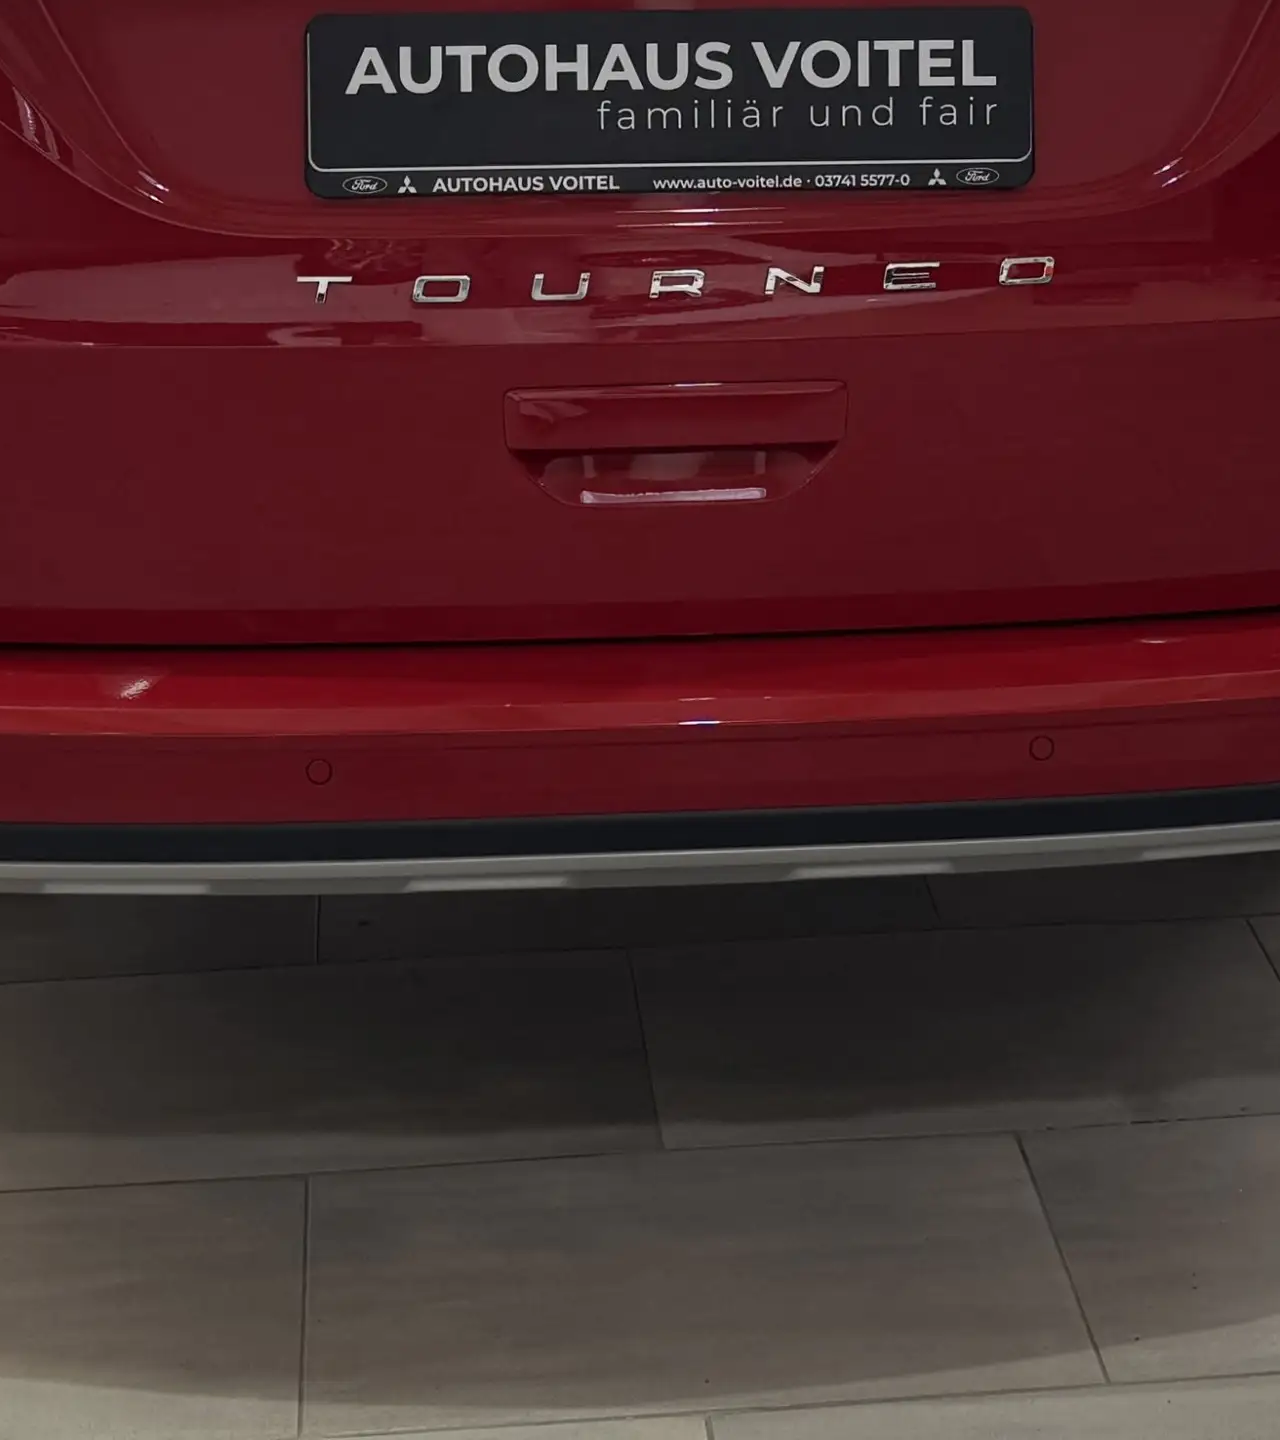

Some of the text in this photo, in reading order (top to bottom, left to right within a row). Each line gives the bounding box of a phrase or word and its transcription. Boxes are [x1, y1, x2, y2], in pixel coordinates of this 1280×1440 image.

[345, 40, 997, 94] AUTOHAUS VOITEL
[597, 95, 998, 131] familiär und fair
[432, 175, 620, 192] AUTOHAUS VOITEL
[653, 173, 910, 189] www.auto-voitel.de 03741 5577-0
[297, 256, 1056, 303] TOURNEO
